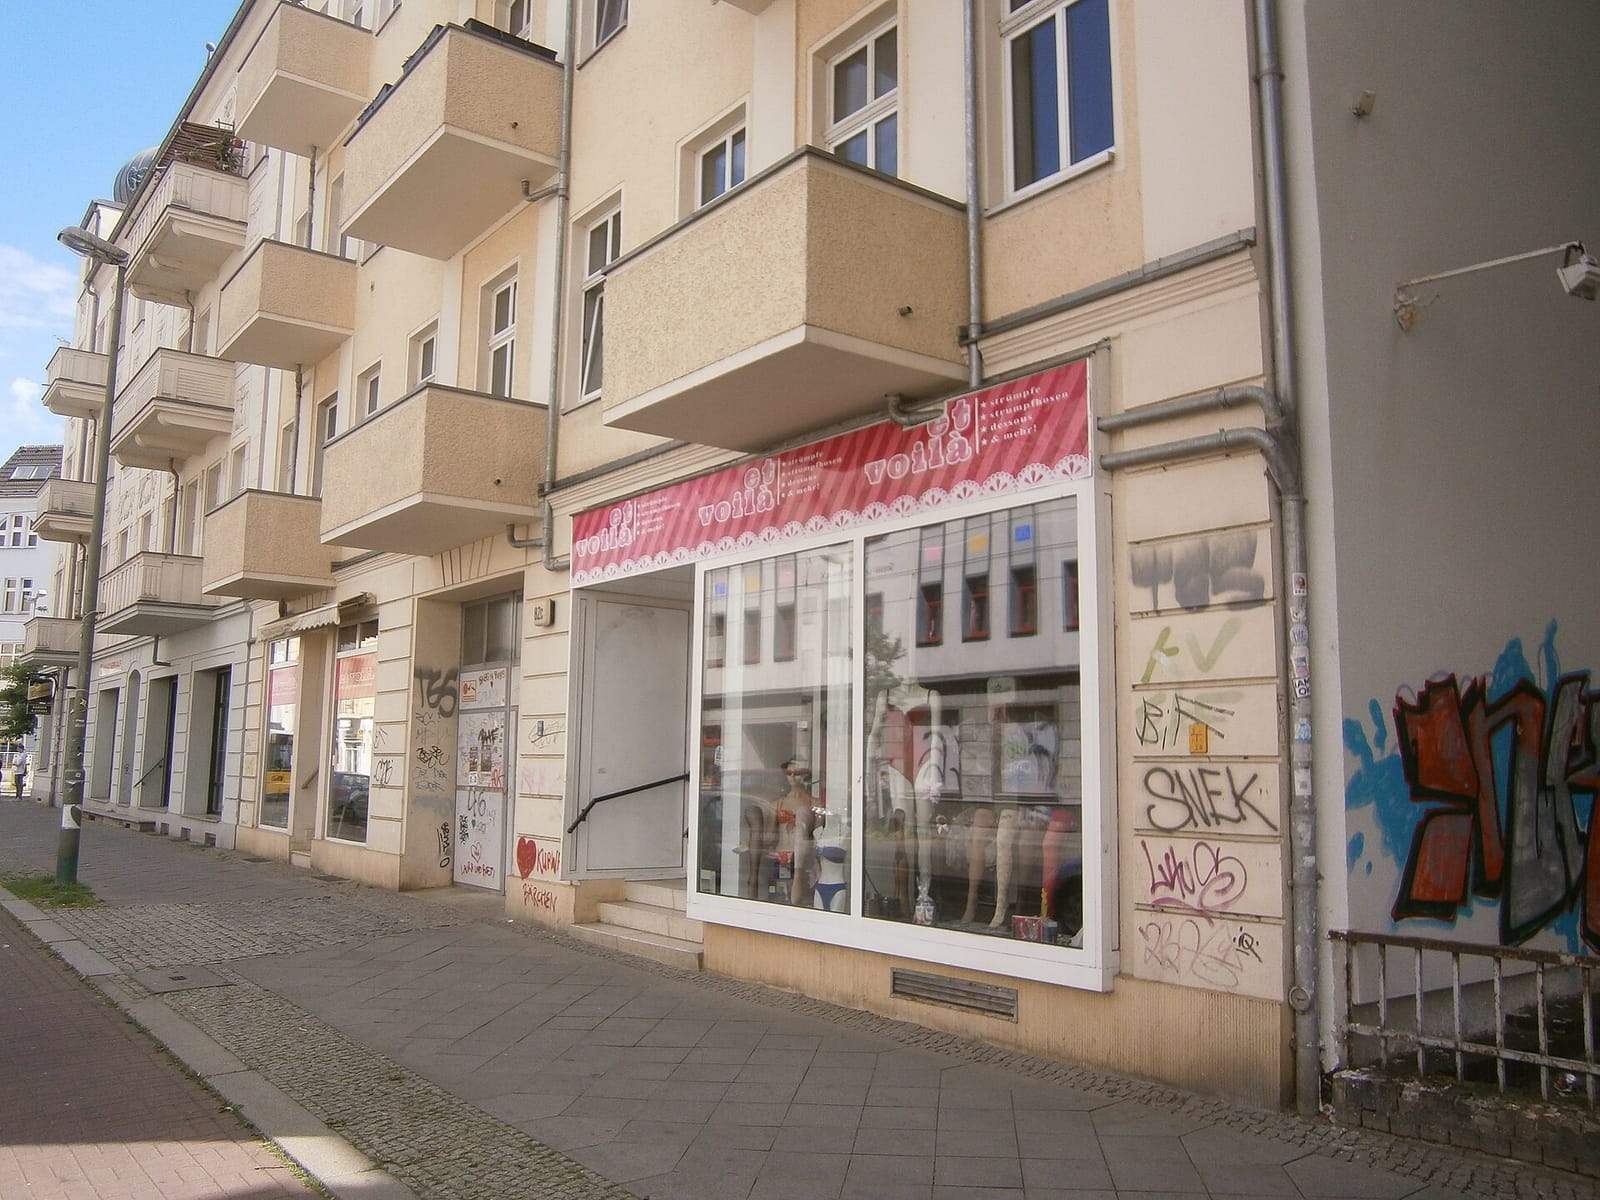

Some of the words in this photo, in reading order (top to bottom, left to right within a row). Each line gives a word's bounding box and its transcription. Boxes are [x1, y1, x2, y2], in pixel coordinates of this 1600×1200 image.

[989, 386, 1041, 406] strümpfe
[927, 399, 971, 437] et
[990, 414, 1033, 431] dessous
[1003, 424, 1037, 441] mehr!
[744, 458, 776, 489] et
[864, 430, 973, 485] voilà
[609, 500, 633, 527] et
[698, 484, 776, 526] voilà
[575, 523, 633, 557] voilà
[1144, 766, 1278, 832] SNEK
